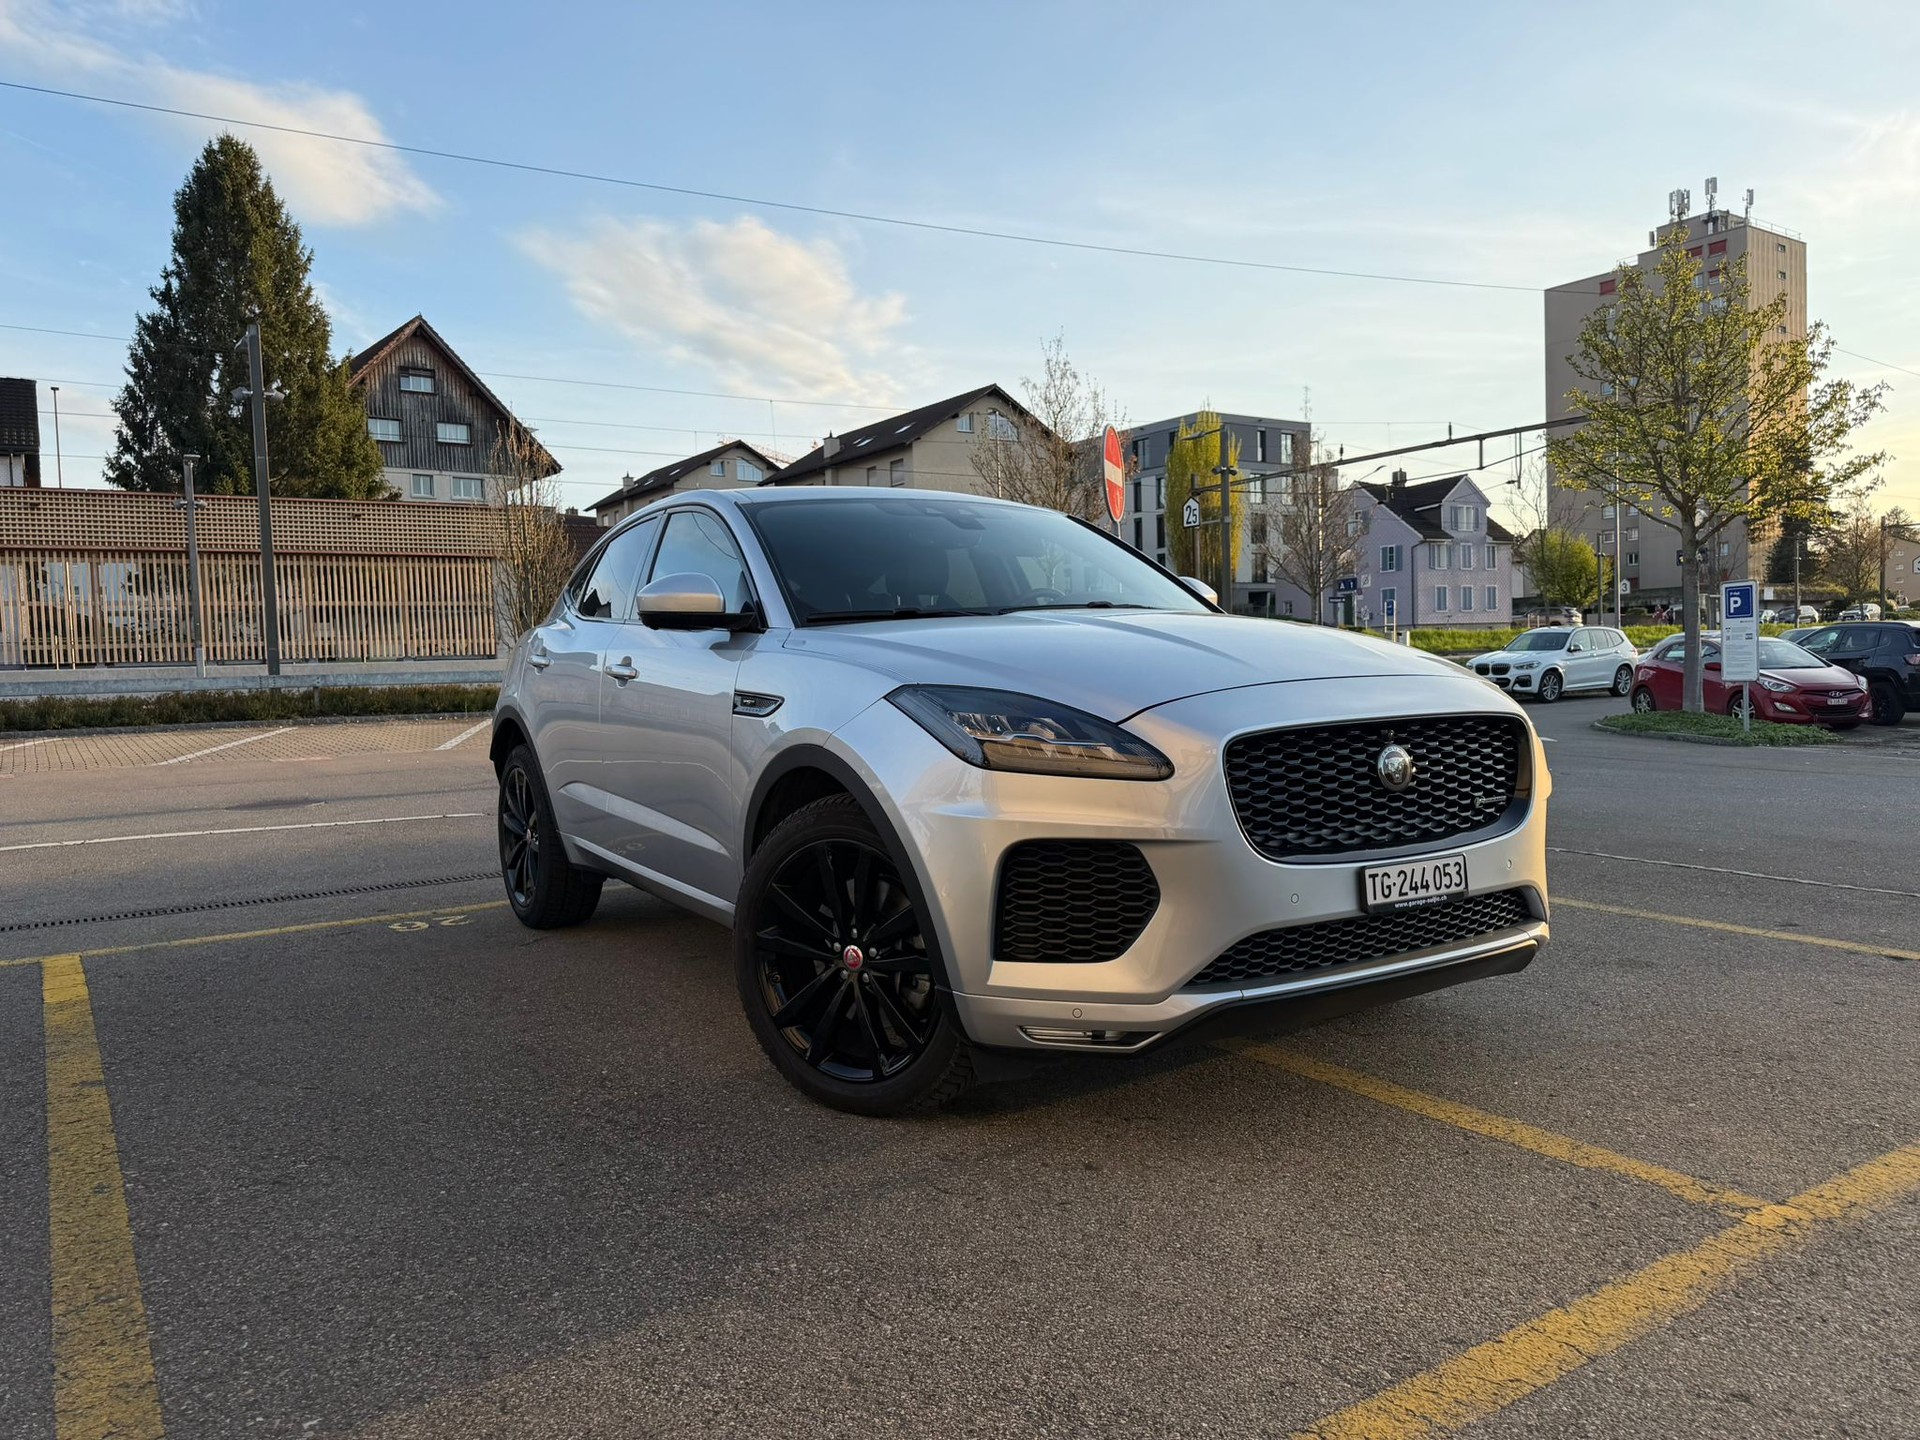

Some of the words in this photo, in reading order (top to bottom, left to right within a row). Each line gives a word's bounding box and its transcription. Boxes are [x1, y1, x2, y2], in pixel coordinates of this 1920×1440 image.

[1186, 506, 1197, 524] 25
[1621, 582, 1628, 592] 3
[1730, 596, 1741, 614] P
